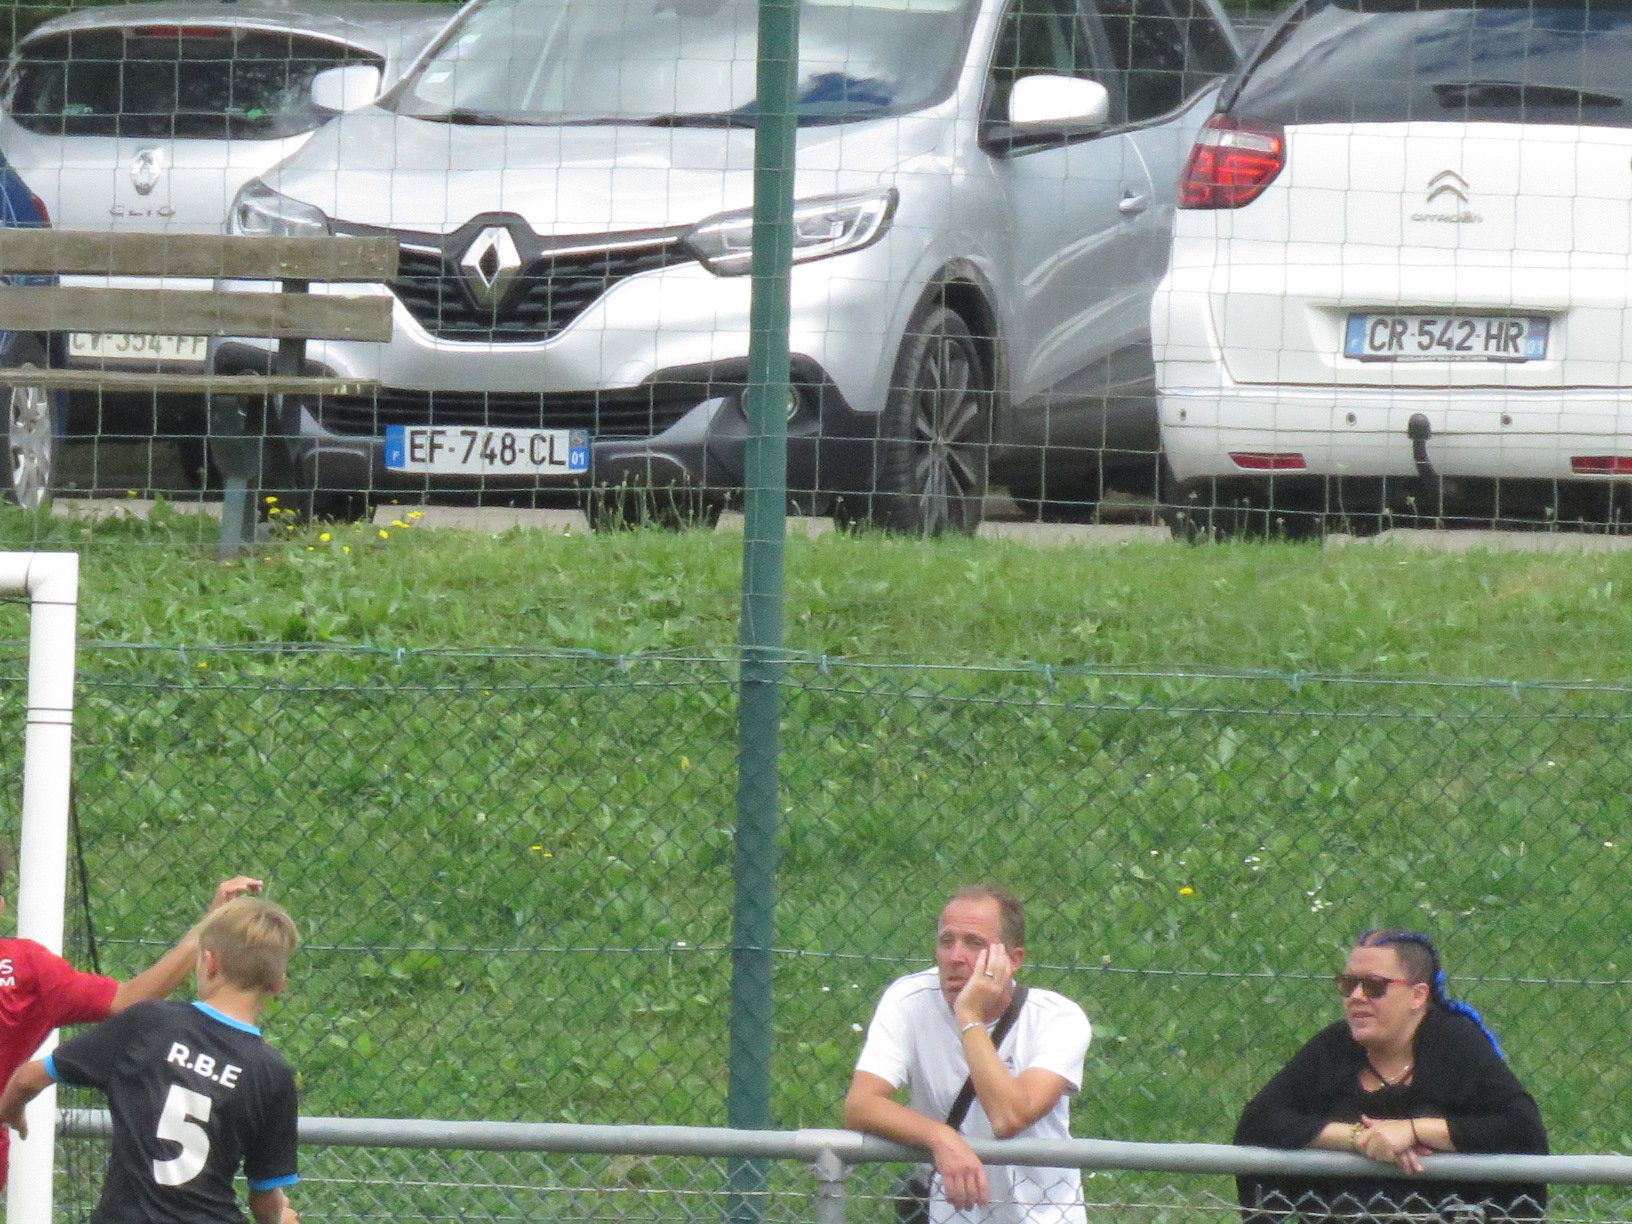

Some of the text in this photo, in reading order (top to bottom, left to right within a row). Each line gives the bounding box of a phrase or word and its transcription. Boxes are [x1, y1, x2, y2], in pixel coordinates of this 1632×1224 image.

[410, 429, 566, 466] EF-748-CL
[571, 451, 585, 465] 01
[166, 1041, 243, 1089] R.B.E
[153, 1084, 213, 1186] 5
